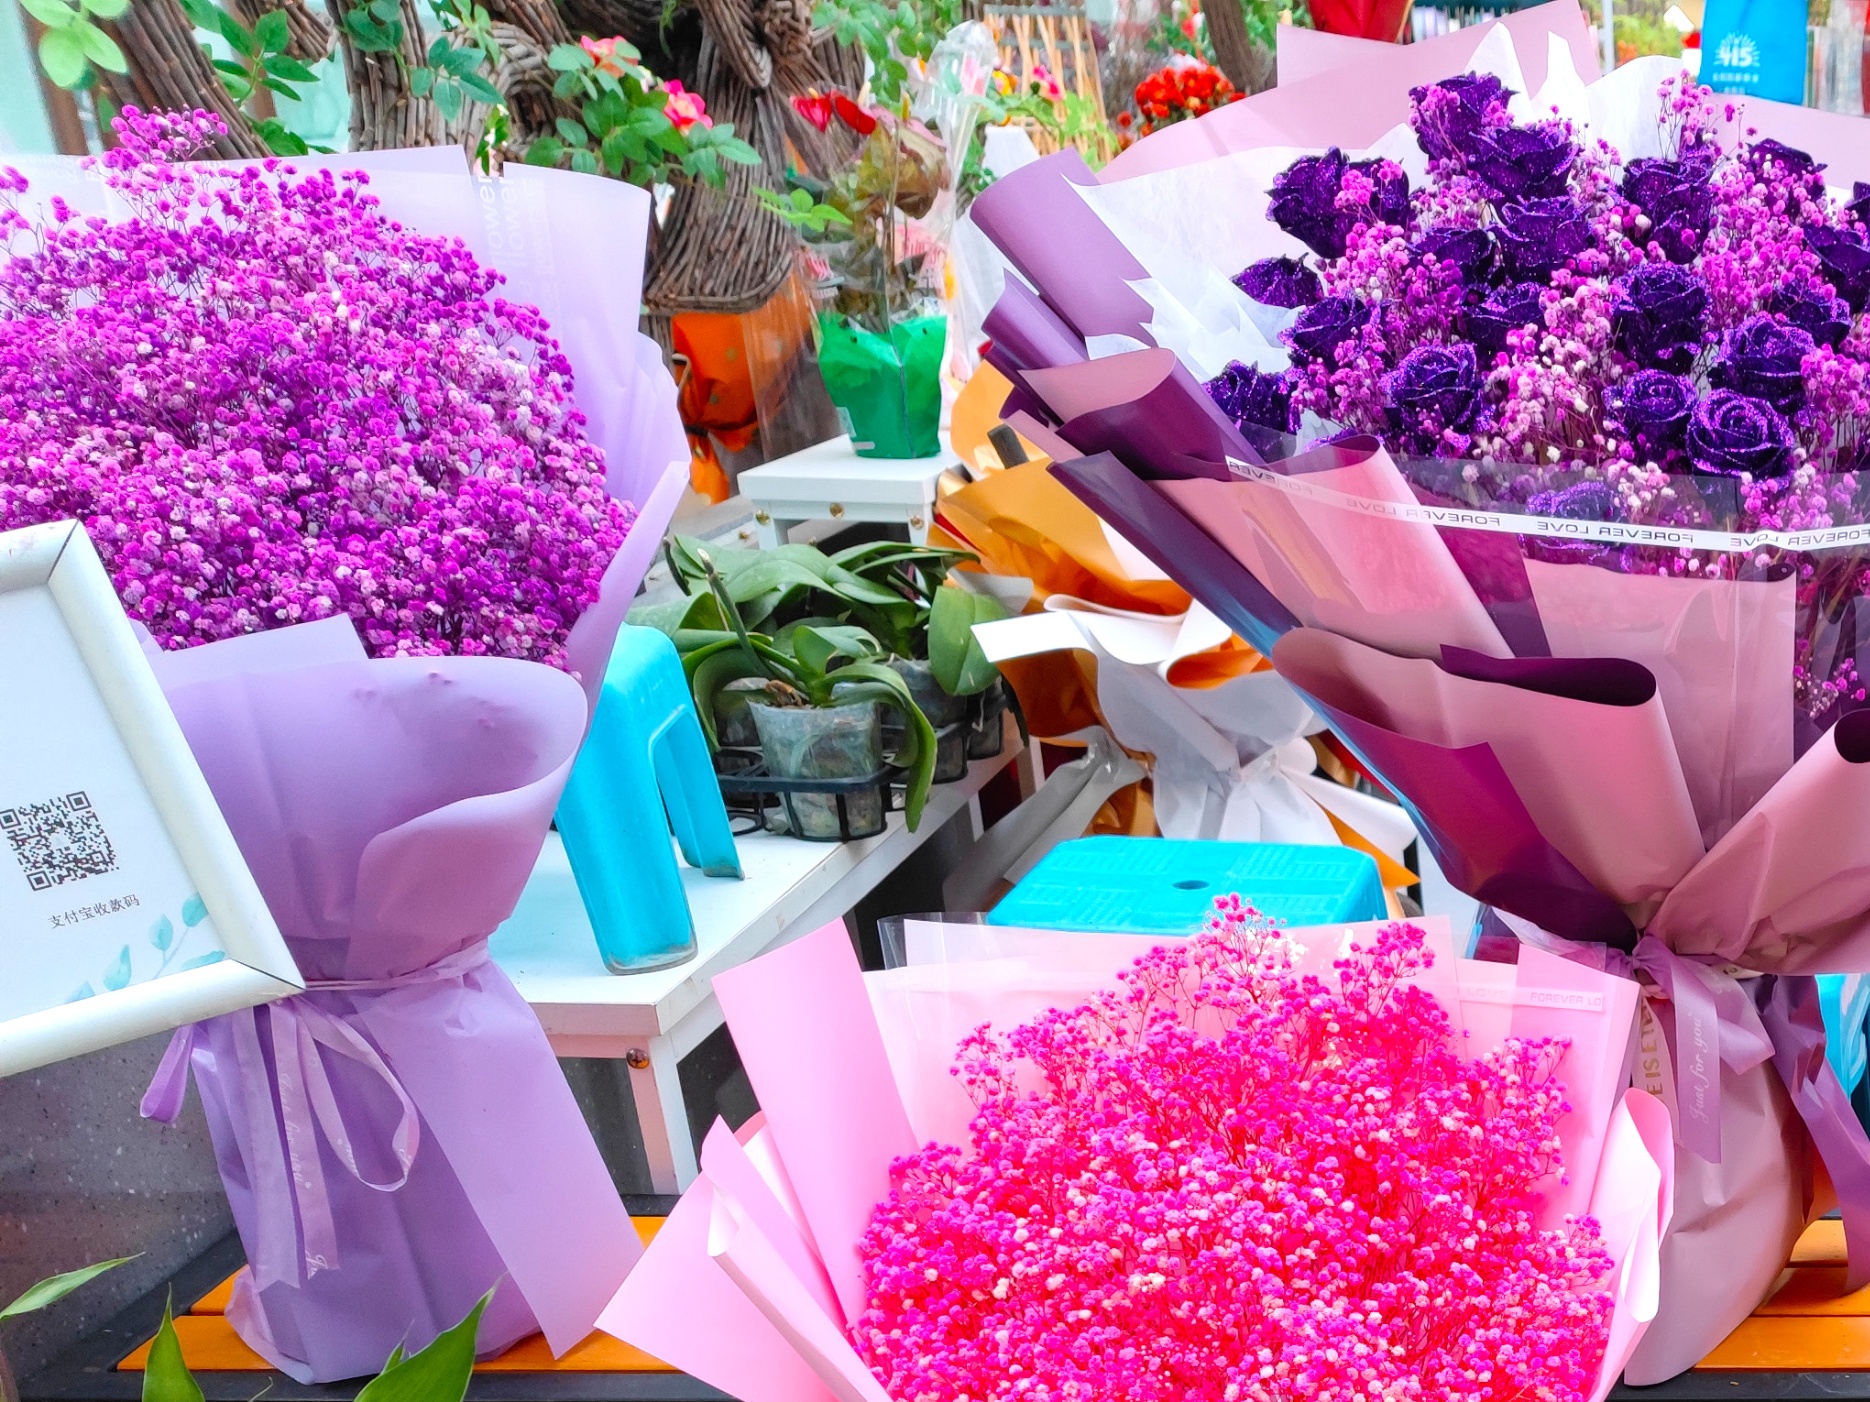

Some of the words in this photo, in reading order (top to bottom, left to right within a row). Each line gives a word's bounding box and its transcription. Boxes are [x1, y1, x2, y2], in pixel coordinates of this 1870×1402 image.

[48, 894, 140, 929] 支付宝收款码
[1530, 992, 1584, 1005] FOREVER
[1692, 1015, 1709, 1053] you
[1690, 1054, 1709, 1088] for
[1689, 1086, 1709, 1124] Just
